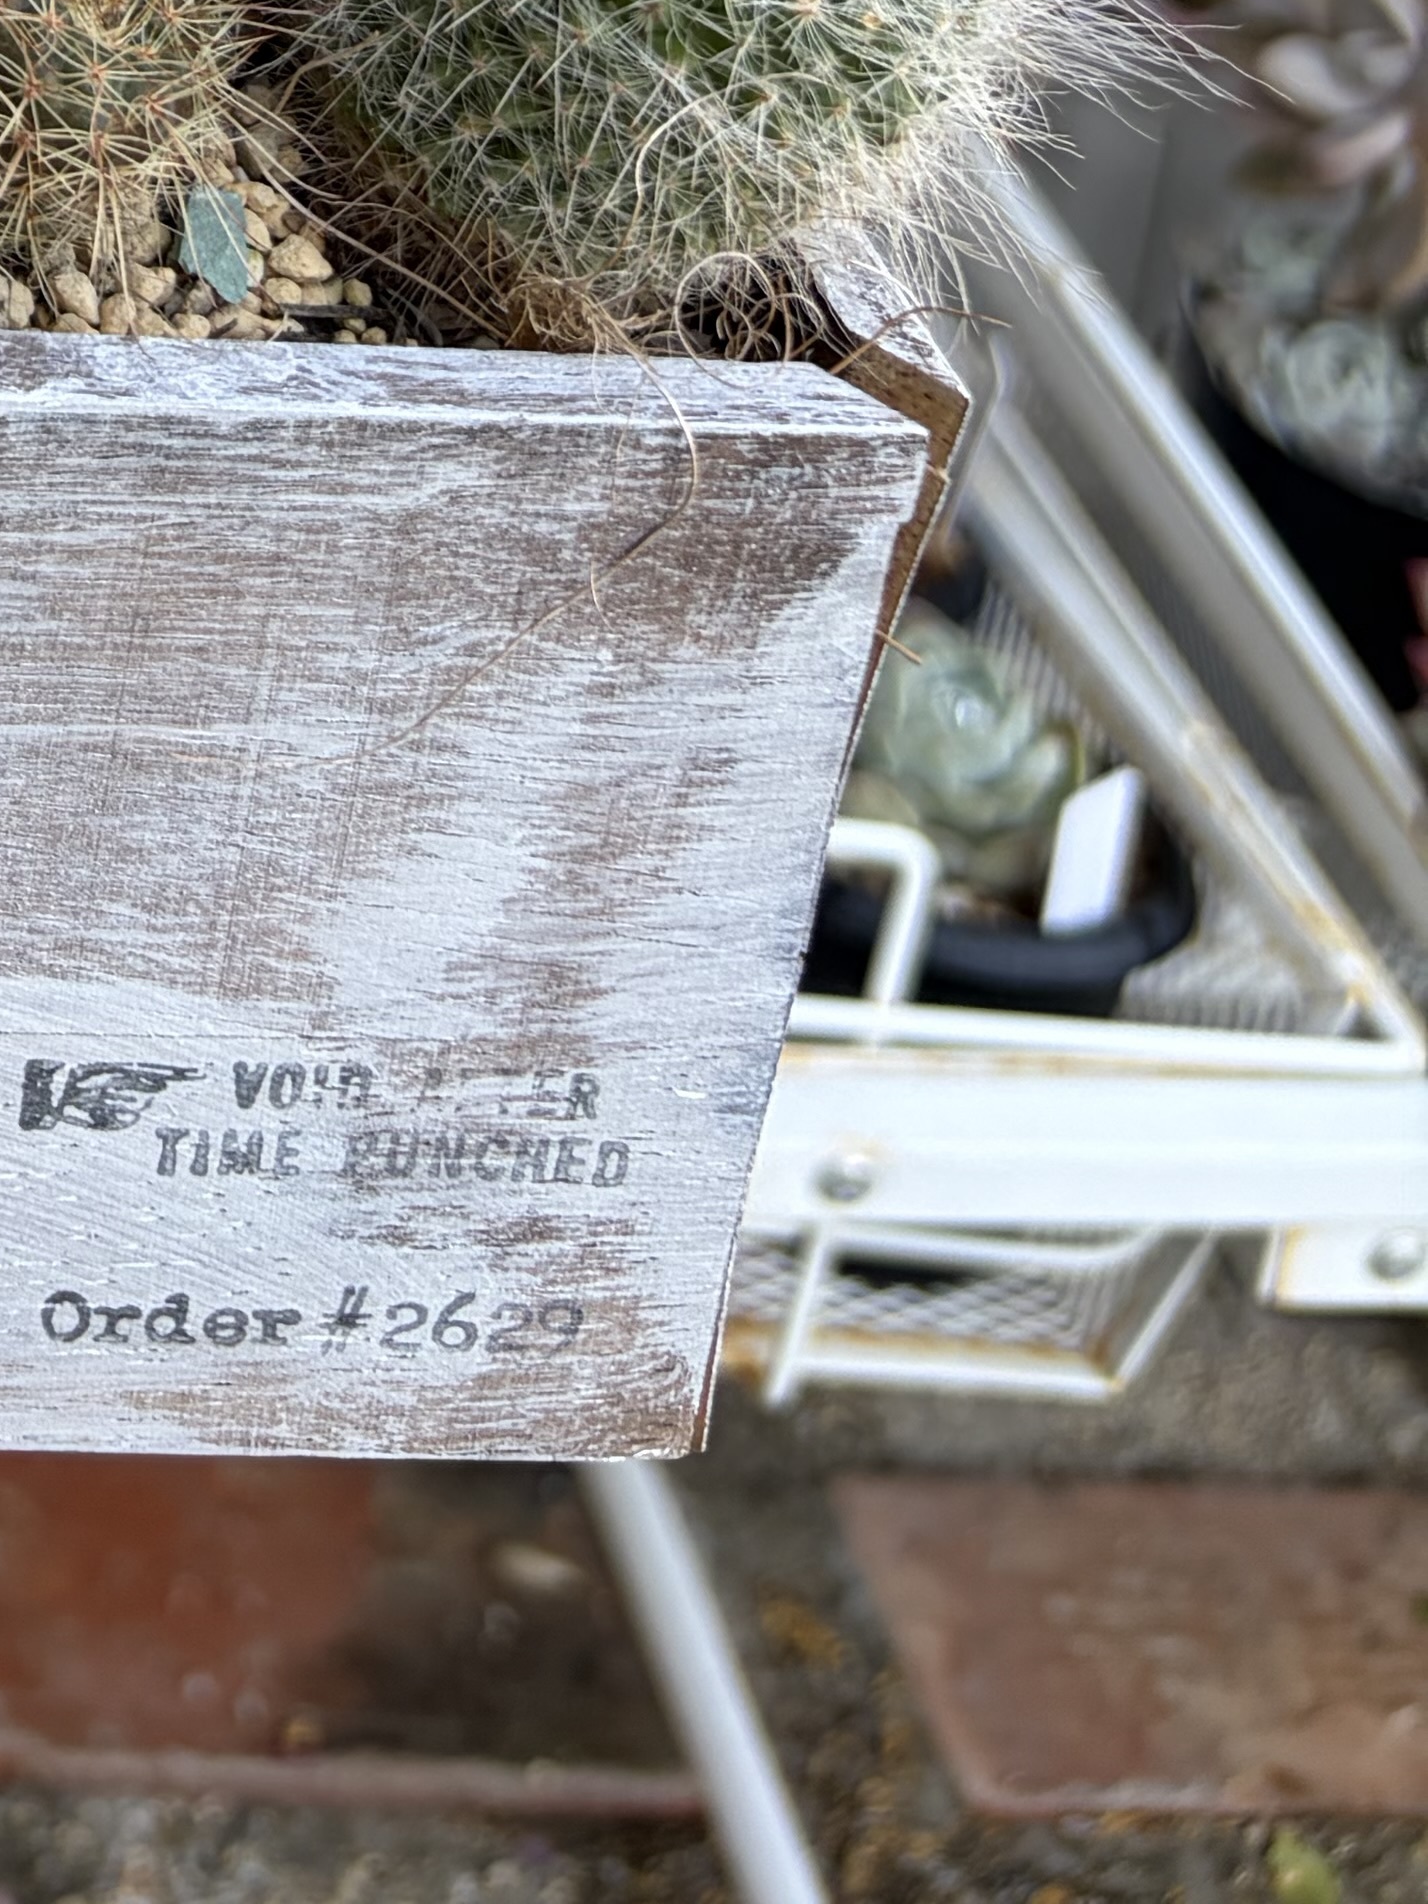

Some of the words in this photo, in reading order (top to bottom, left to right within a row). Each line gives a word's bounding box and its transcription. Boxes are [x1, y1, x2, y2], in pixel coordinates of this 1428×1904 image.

[154, 1127, 301, 1176] TIME
[344, 1130, 631, 1187] PUNCHED
[40, 1290, 302, 1346] Order
[318, 1285, 584, 1356] #2629
